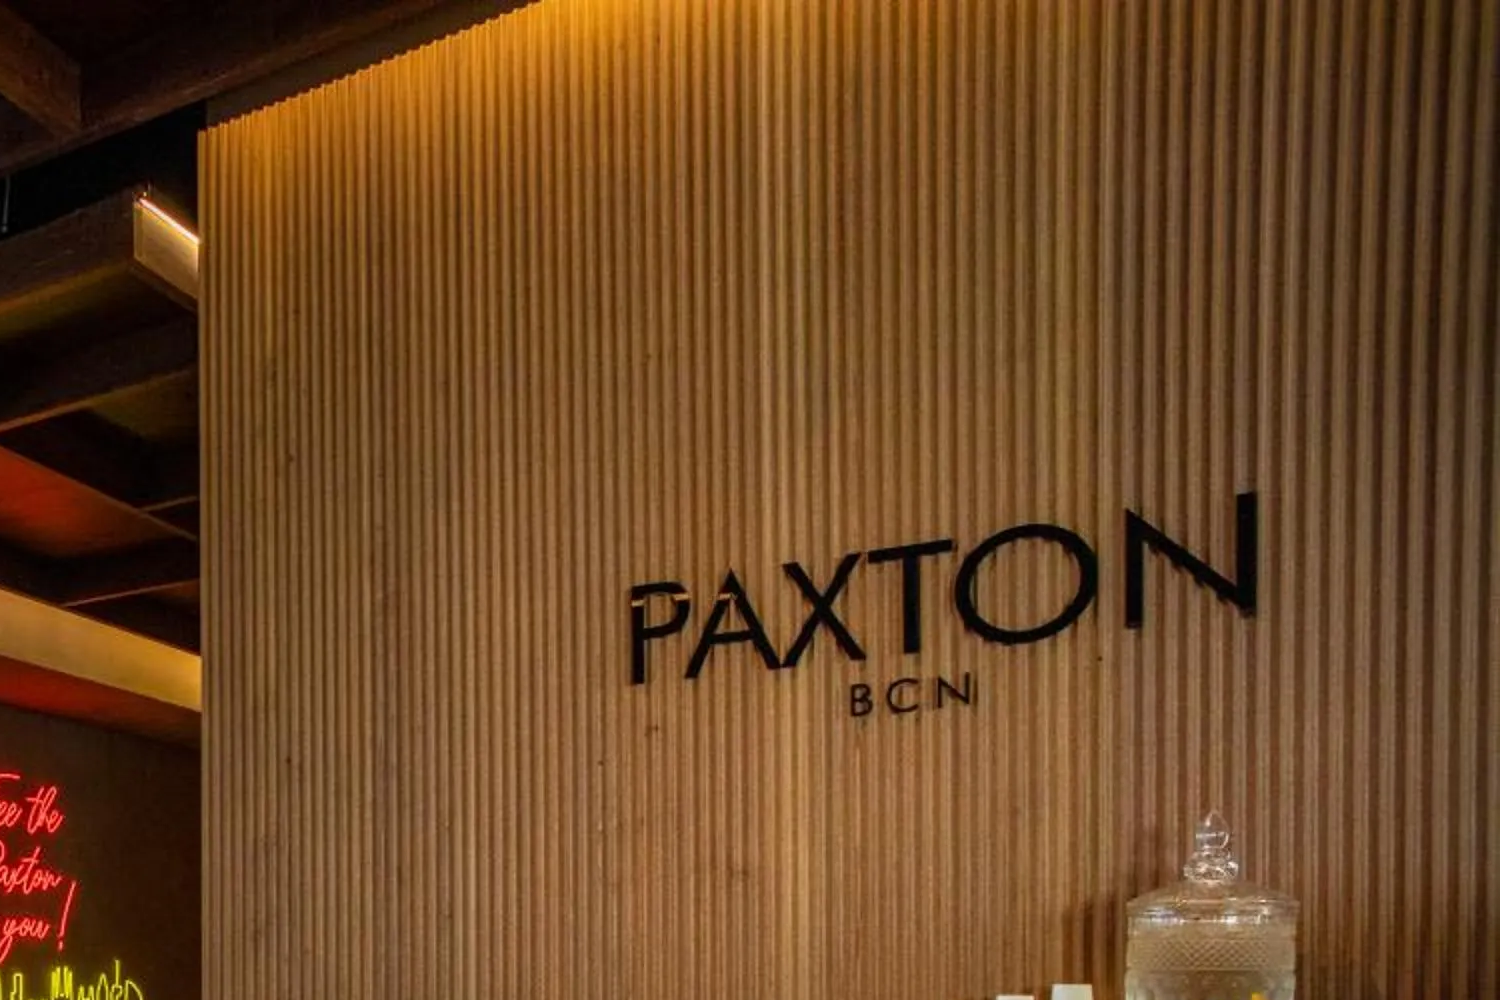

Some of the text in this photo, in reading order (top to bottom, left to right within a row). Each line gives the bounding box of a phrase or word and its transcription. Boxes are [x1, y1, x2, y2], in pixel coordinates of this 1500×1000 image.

[630, 491, 1258, 685] PAXTON
[849, 672, 978, 718] BCN
[25, 786, 64, 833] the
